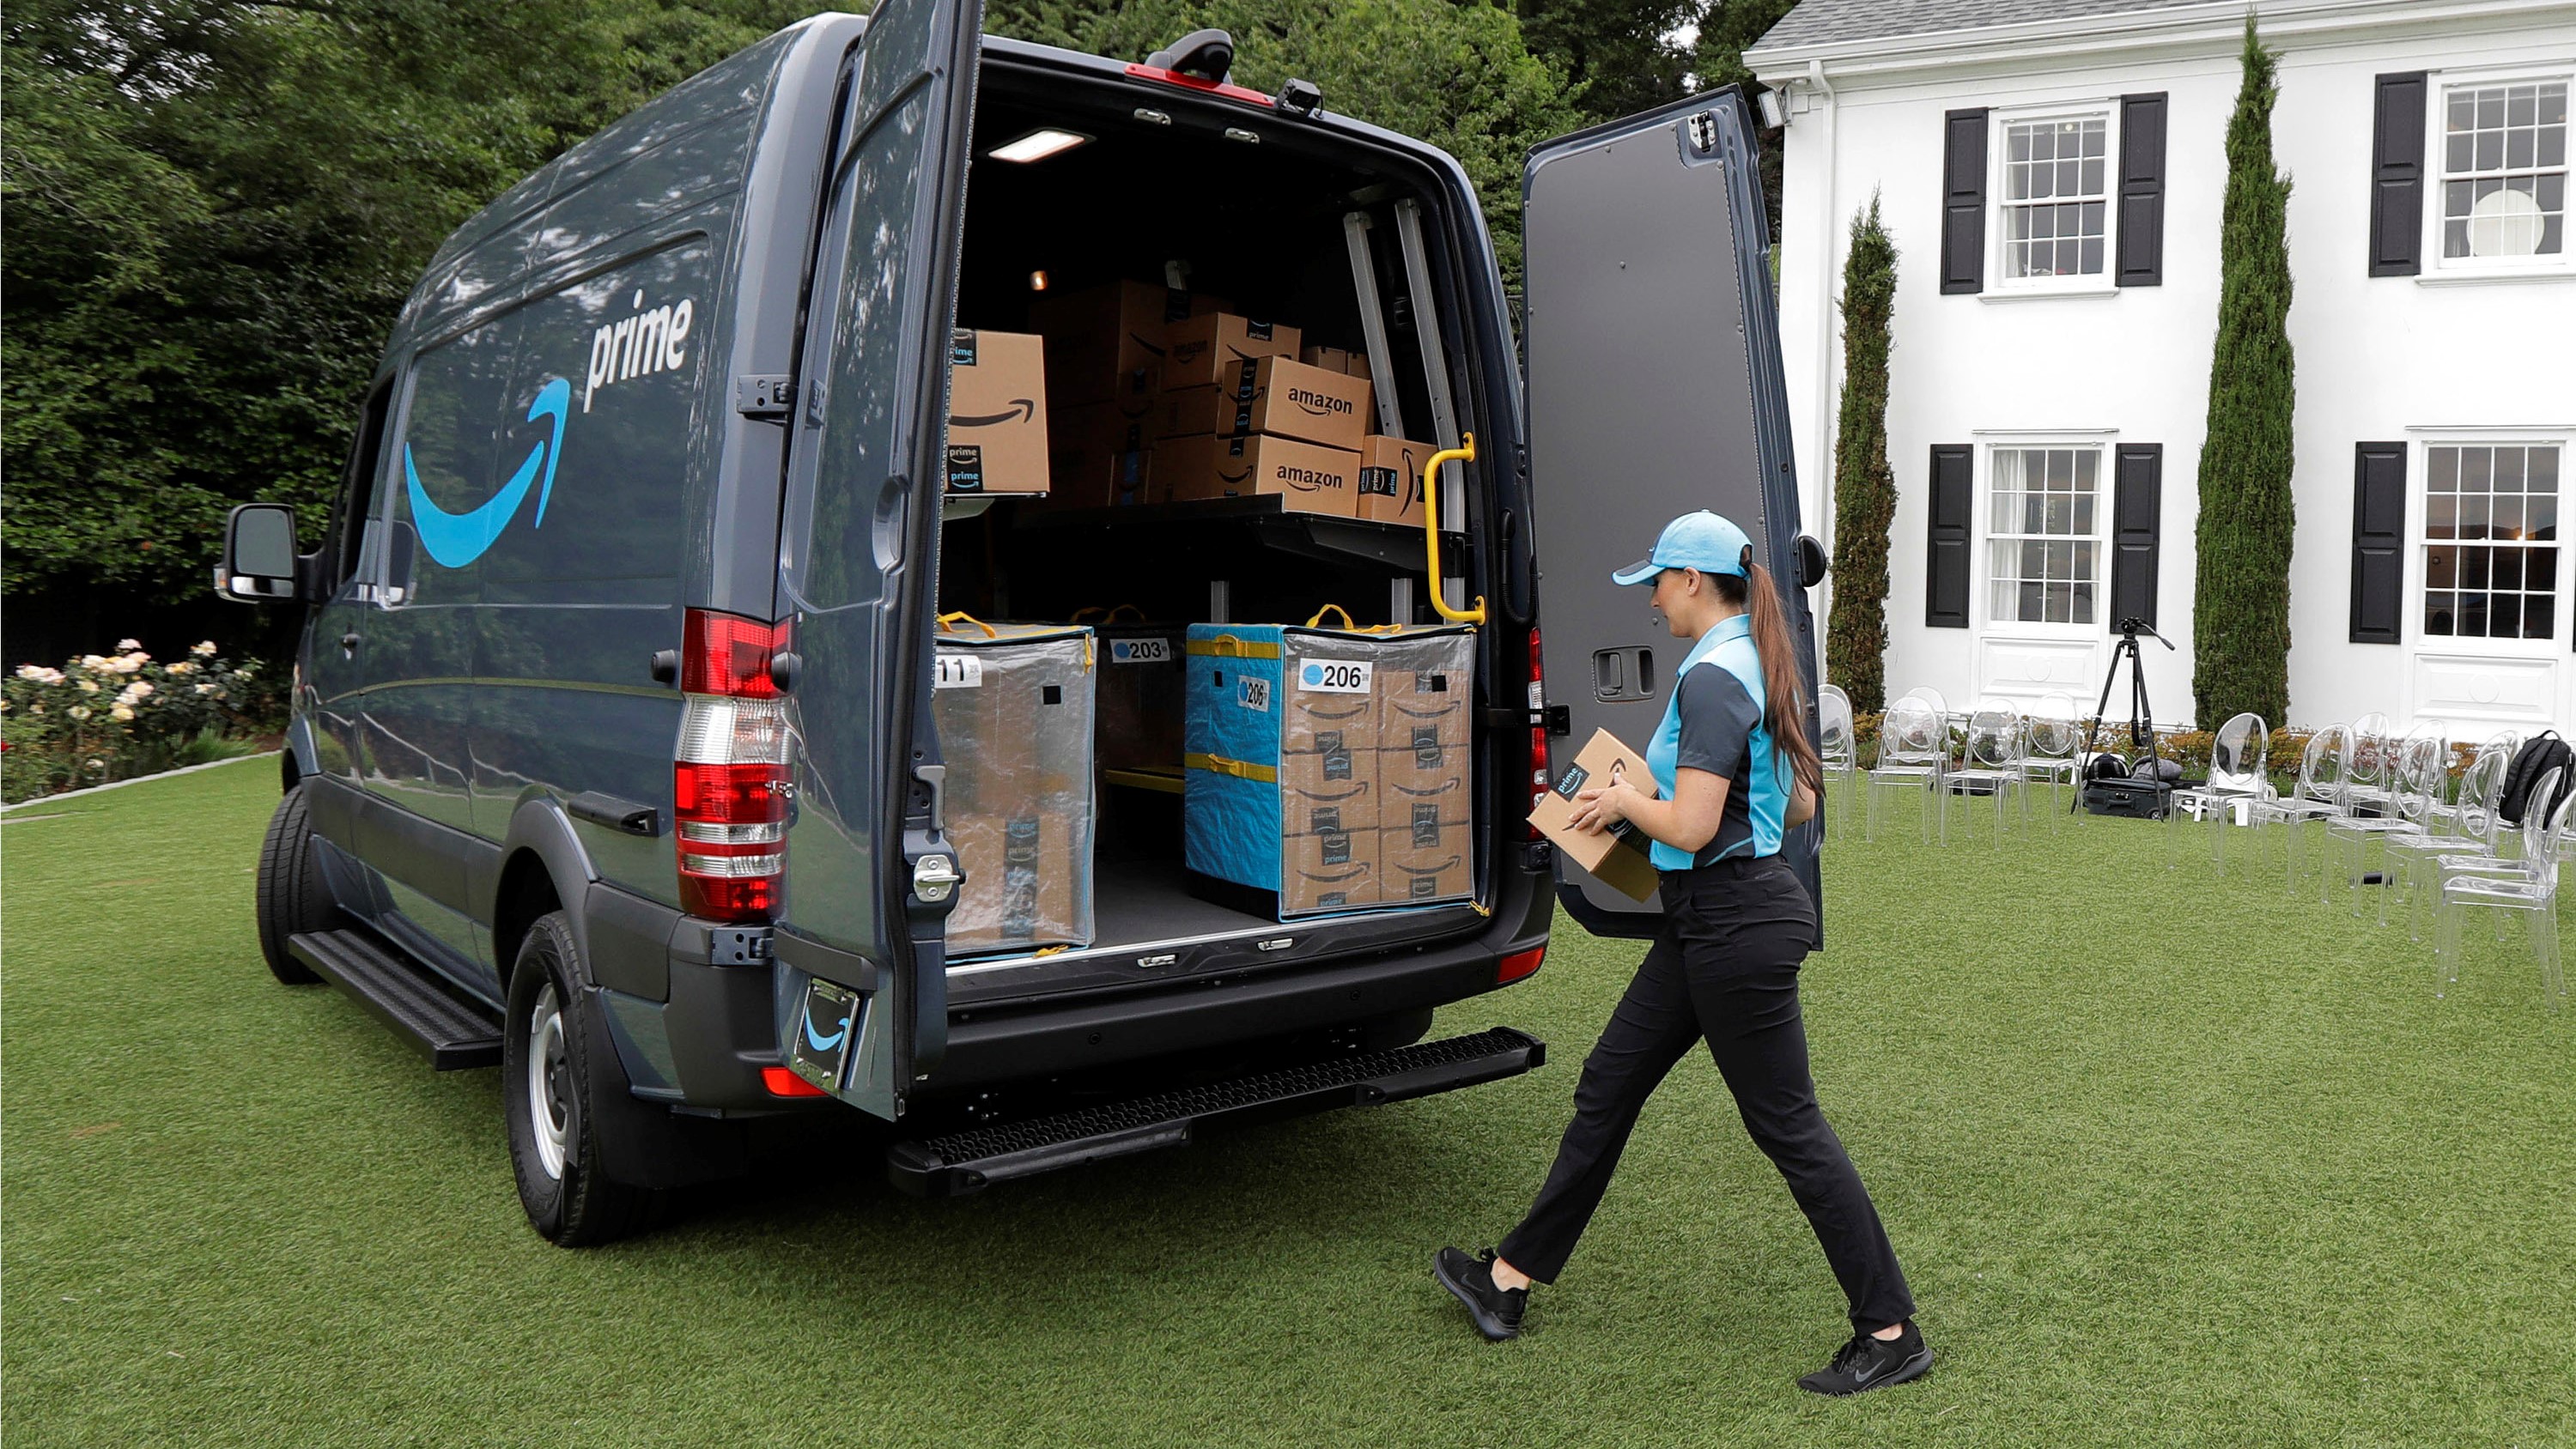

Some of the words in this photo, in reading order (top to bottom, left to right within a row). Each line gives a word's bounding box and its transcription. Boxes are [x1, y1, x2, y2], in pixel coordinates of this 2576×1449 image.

[1249, 331, 1269, 340] prime
[583, 288, 692, 413] prime
[955, 347, 973, 355] ime
[1288, 387, 1352, 415] amazon
[950, 447, 977, 458] prime
[951, 471, 979, 482] prime
[1276, 465, 1342, 488] amazon
[1129, 641, 1162, 658] 203
[1324, 665, 1362, 688] 206
[1248, 682, 1264, 706] 206
[1558, 767, 1578, 793] prime
[1314, 810, 1337, 819] prime
[1324, 834, 1346, 843] prime
[1324, 855, 1347, 864] prime
